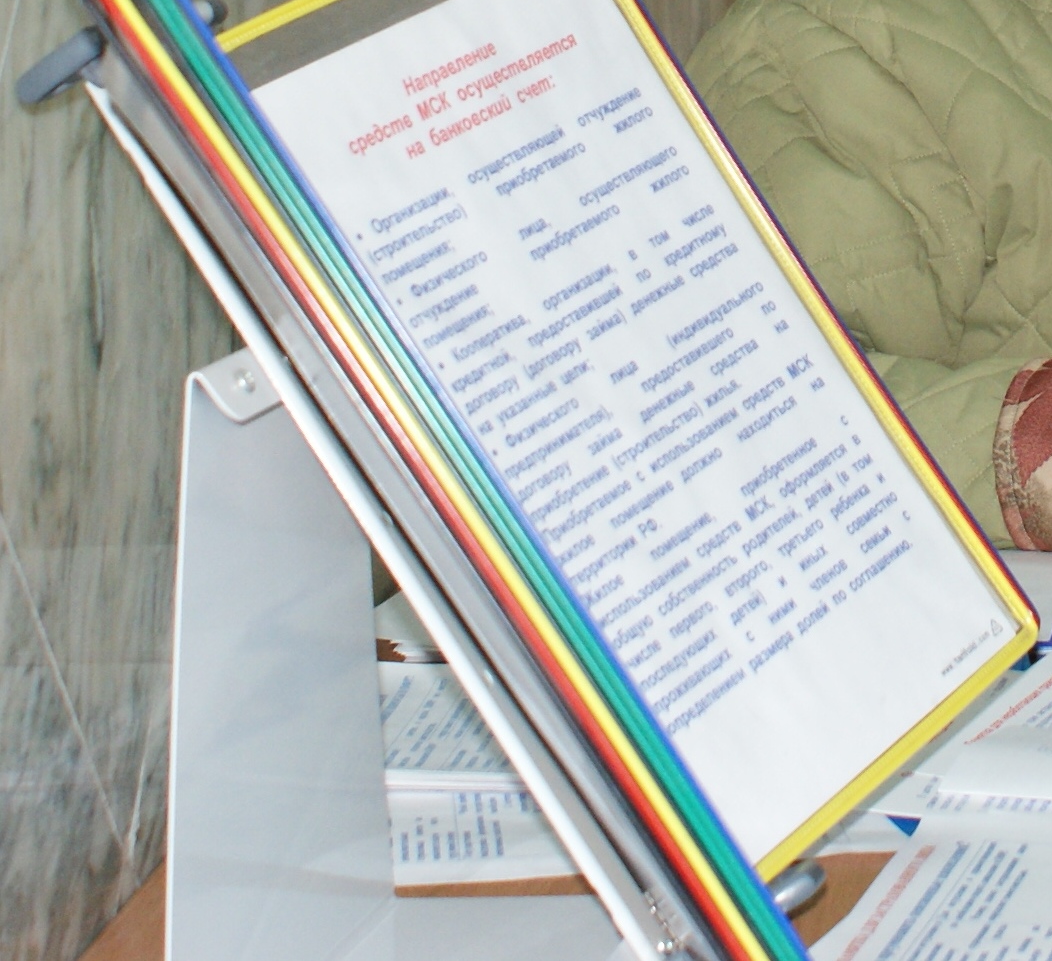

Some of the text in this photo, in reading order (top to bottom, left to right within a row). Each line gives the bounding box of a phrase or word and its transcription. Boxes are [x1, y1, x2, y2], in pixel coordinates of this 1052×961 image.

[348, 34, 577, 156] средств МСК осуществляется
[402, 43, 497, 96] Направление
[405, 75, 556, 160] на банковский счет:
[467, 124, 565, 184] осуществляющей
[577, 87, 642, 127] отчуждение
[496, 142, 586, 196] приобретаемого
[612, 106, 654, 134] жилого
[409, 165, 690, 328] отчуждение приобретаемого жилого
[410, 251, 488, 298] Физического
[579, 146, 677, 207] осуществляющего
[627, 249, 639, 262] в
[648, 229, 671, 248] том
[681, 204, 715, 227] числе
[465, 377, 520, 416] договору
[523, 338, 582, 381] (договору
[630, 275, 685, 317] денежные
[689, 242, 739, 278] средства
[528, 283, 623, 347] предоставившей
[635, 268, 652, 284] по
[663, 223, 727, 267] кредитному
[641, 328, 734, 392] предоставившего
[760, 300, 777, 316] по
[479, 419, 494, 435] на
[497, 381, 558, 428] указанные
[505, 282, 764, 448] Физического лица (индивидуального
[587, 427, 623, 456] займа
[639, 380, 695, 425] денежные
[710, 339, 759, 376] средства
[773, 319, 790, 335] на
[635, 470, 646, 483] с
[650, 408, 739, 473] использованием
[742, 376, 786, 411] средств
[785, 353, 814, 380] МСК
[610, 480, 674, 528] помещение
[680, 447, 723, 485] должно
[736, 395, 797, 443] находиться
[809, 376, 826, 393] на
[696, 520, 742, 558] средств
[779, 443, 848, 498] оформляется
[851, 433, 862, 447] в
[740, 437, 817, 497] приобретенное
[839, 414, 850, 427] с
[658, 556, 738, 616] собственность
[804, 479, 834, 511] детей
[835, 470, 850, 487] (в
[851, 453, 874, 473] том
[777, 519, 824, 557] третьего
[830, 484, 871, 522] ребенка
[875, 472, 886, 484] и
[777, 575, 788, 589] и
[798, 544, 828, 572] иных
[846, 491, 898, 536] совместно
[745, 630, 756, 643] с
[767, 597, 798, 625] ними
[809, 559, 848, 591] членов
[859, 525, 892, 554] семьи
[901, 509, 912, 522] с
[748, 631, 795, 674] размера
[796, 600, 831, 636] долей
[831, 589, 848, 606] по
